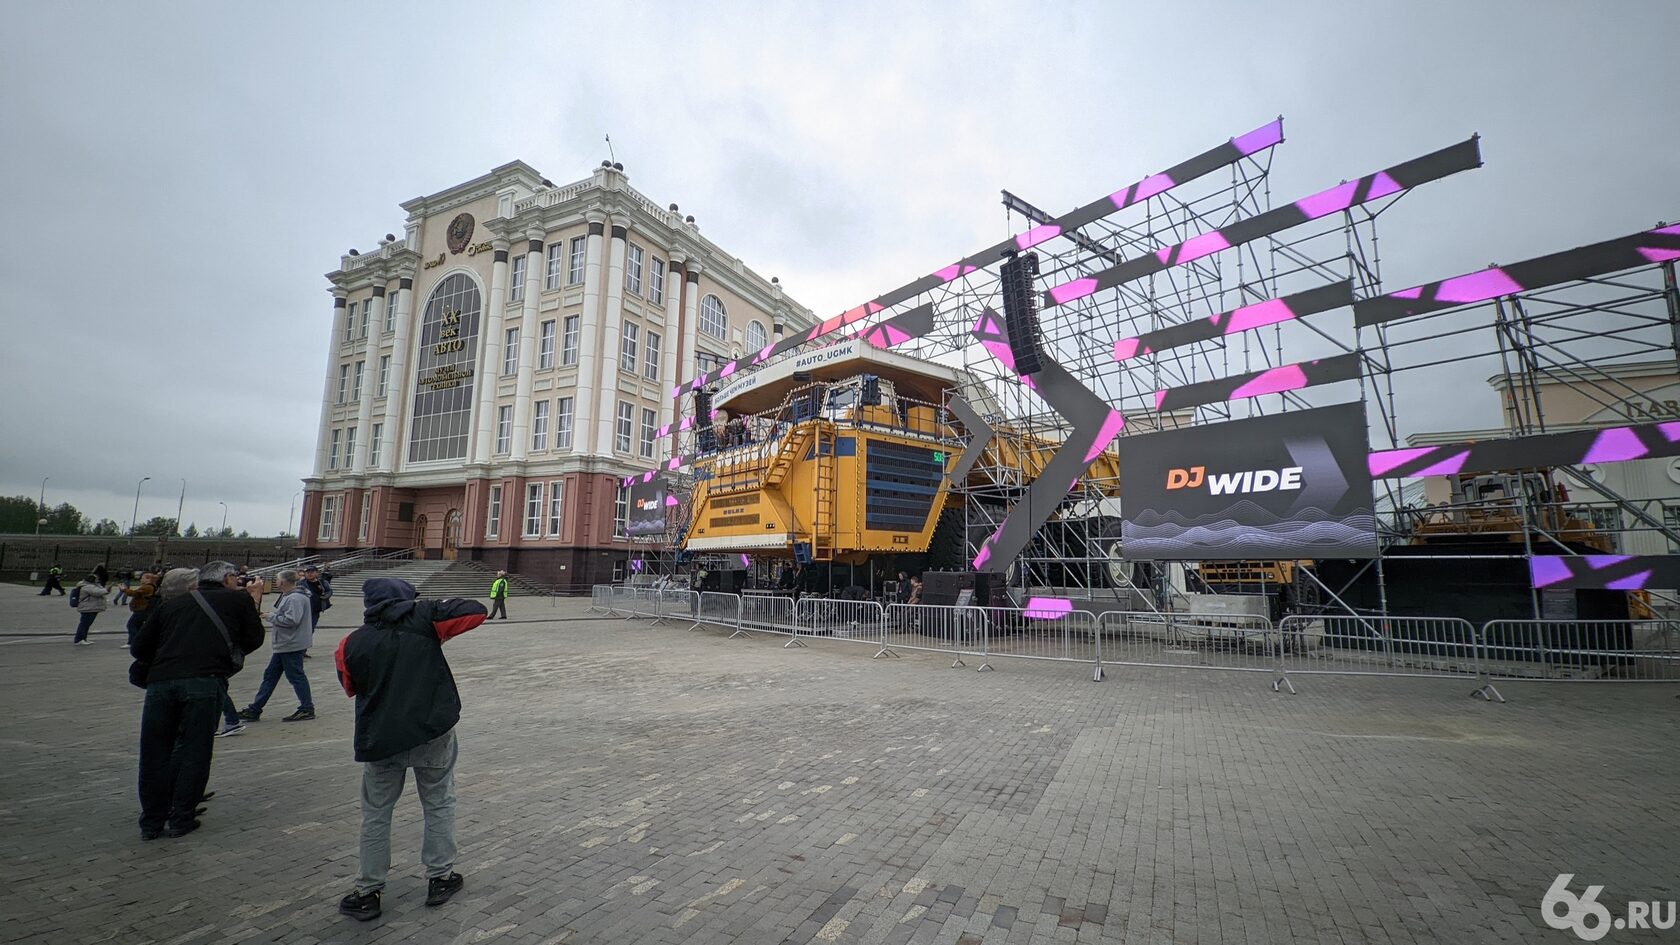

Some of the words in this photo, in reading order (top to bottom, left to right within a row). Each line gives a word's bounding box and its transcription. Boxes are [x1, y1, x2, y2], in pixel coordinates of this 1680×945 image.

[434, 340, 463, 355] АВТО
[796, 346, 852, 367] #AUTO_UGMK
[1166, 466, 1205, 490] DJ
[1207, 466, 1303, 496] WIDE
[643, 500, 658, 511] WIDE
